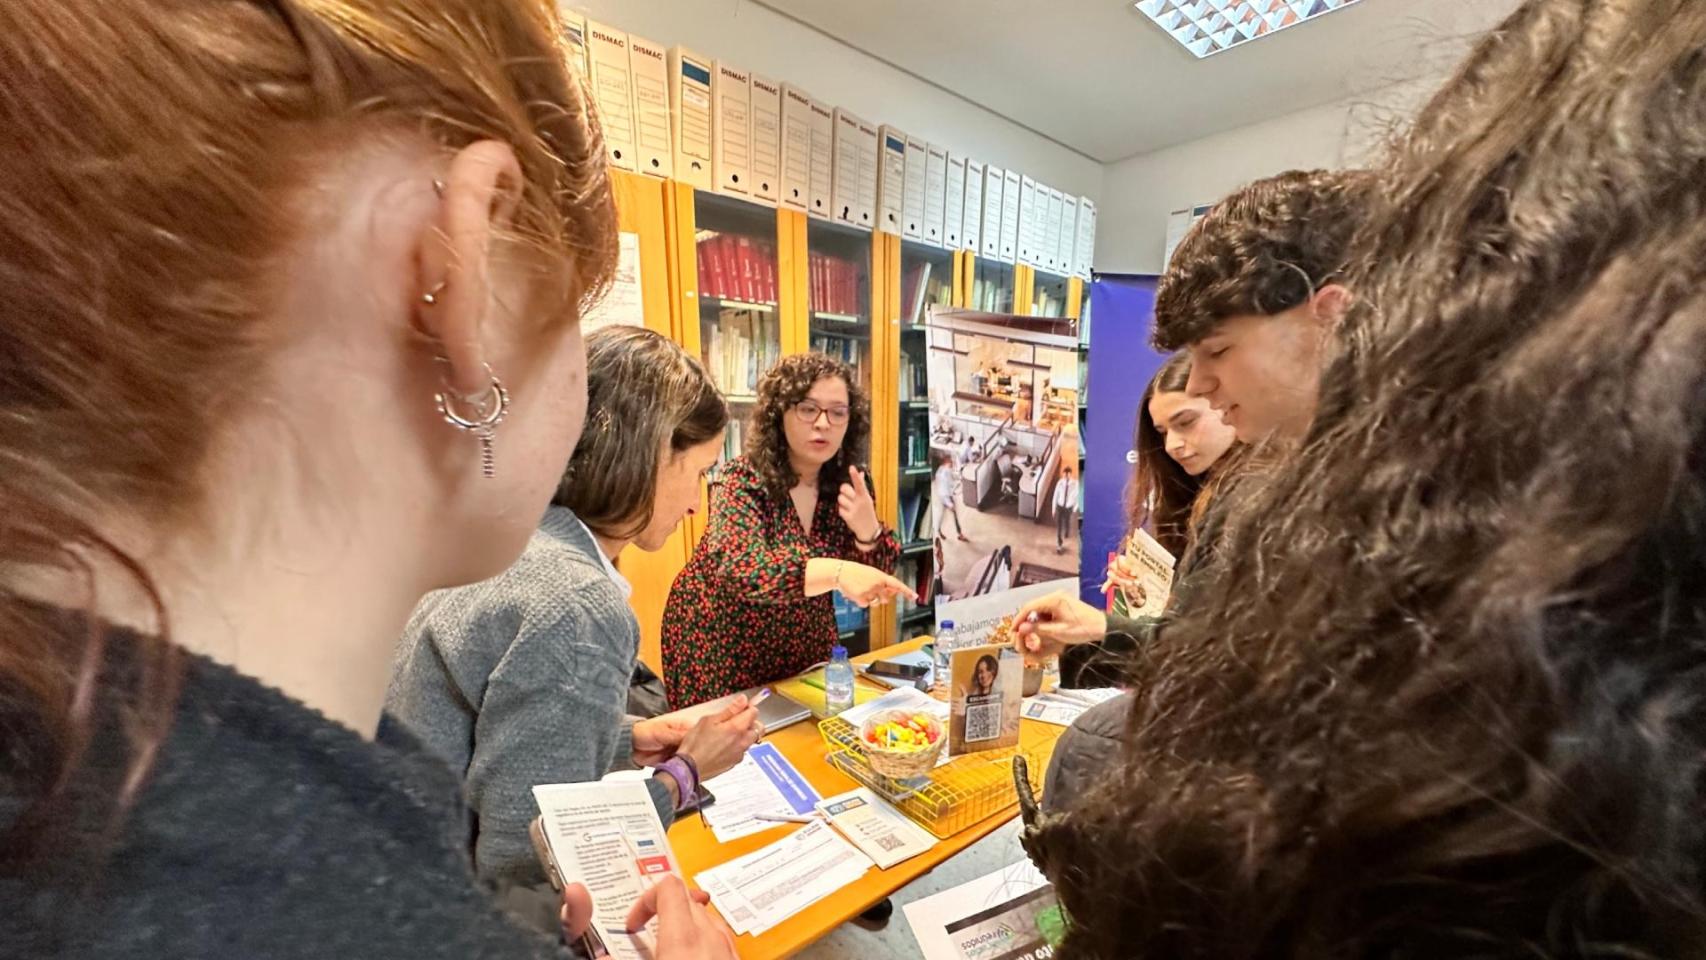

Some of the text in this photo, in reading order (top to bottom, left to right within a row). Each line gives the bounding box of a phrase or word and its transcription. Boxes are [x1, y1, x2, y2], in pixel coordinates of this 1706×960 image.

[592, 31, 624, 48] DISMAC
[633, 44, 663, 60] DISMAC
[720, 67, 747, 83] DISMAC
[753, 80, 778, 96] DISMAC
[1140, 557, 1168, 582] EMPLEO
